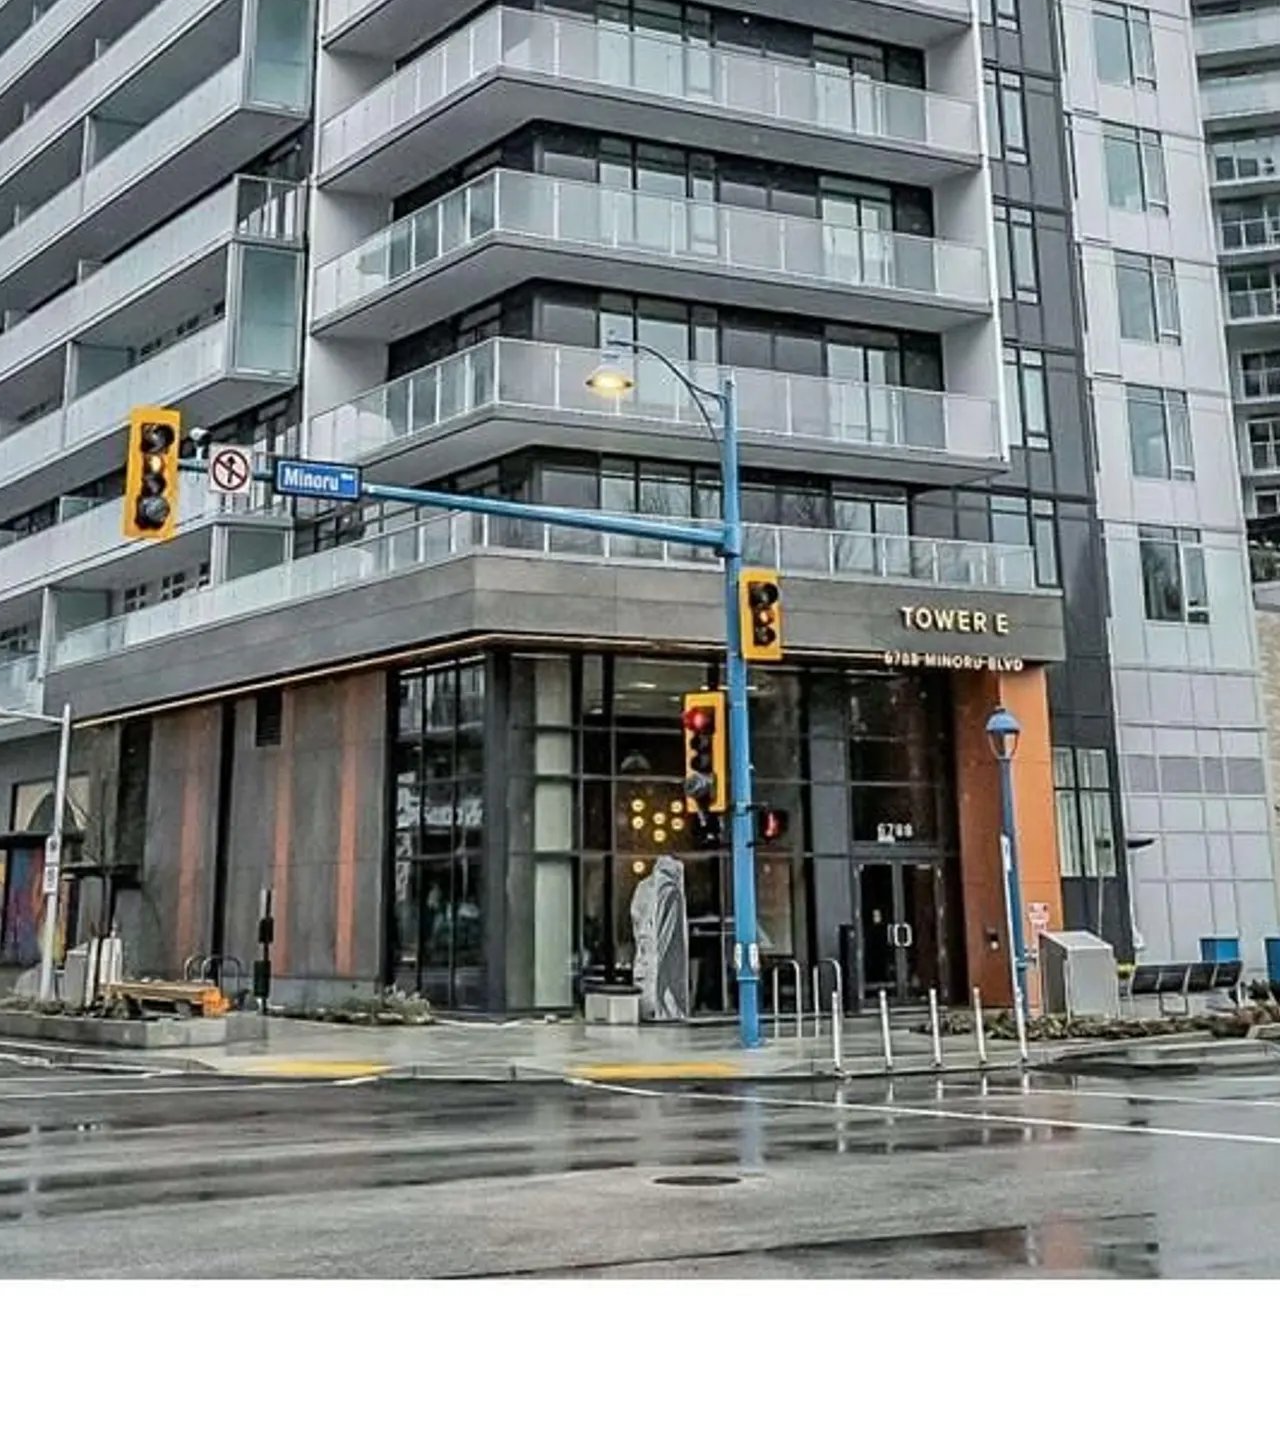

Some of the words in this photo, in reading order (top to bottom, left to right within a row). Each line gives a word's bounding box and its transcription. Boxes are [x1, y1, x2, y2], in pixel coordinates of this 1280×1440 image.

[284, 466, 339, 491] Minoru
[900, 605, 988, 634] TOWER
[996, 613, 1011, 635] E
[924, 652, 982, 670] MINORU
[987, 655, 1024, 672] BLVD
